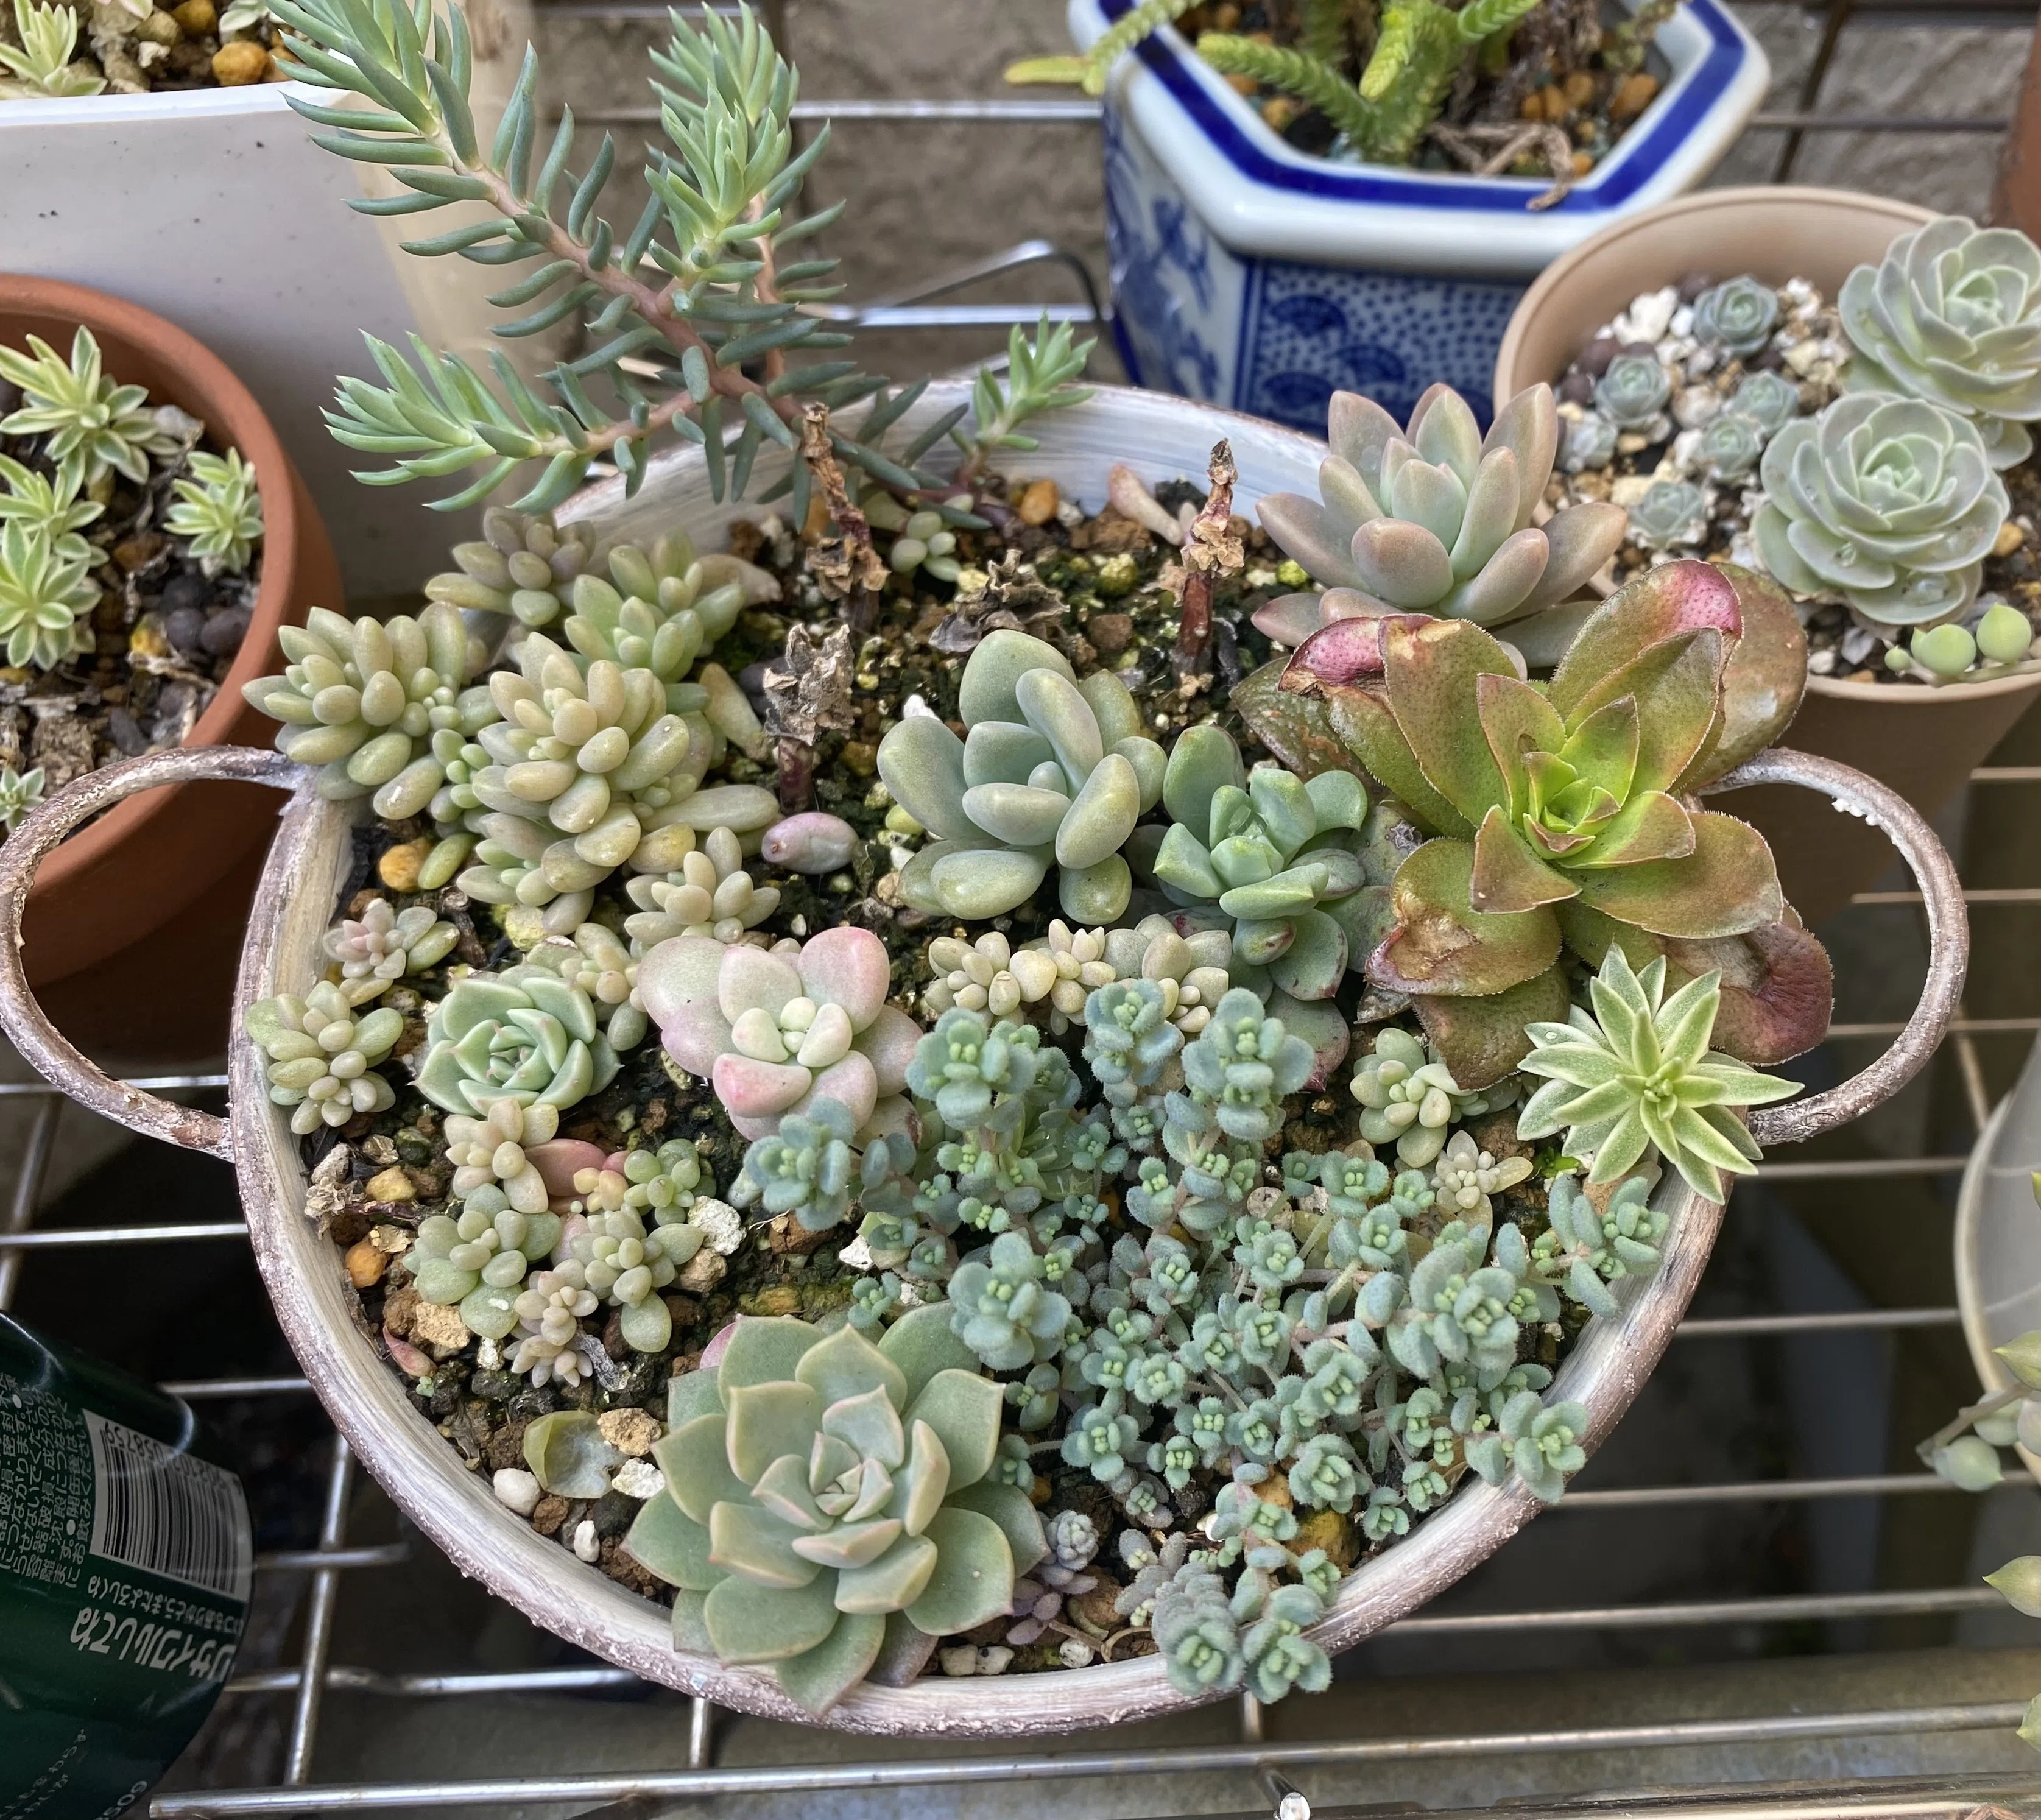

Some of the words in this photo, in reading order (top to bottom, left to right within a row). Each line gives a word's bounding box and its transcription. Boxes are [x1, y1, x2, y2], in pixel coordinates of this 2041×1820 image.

[105, 1421, 166, 1463] 058759
[70, 1607, 236, 1683] リサイクルしてね
